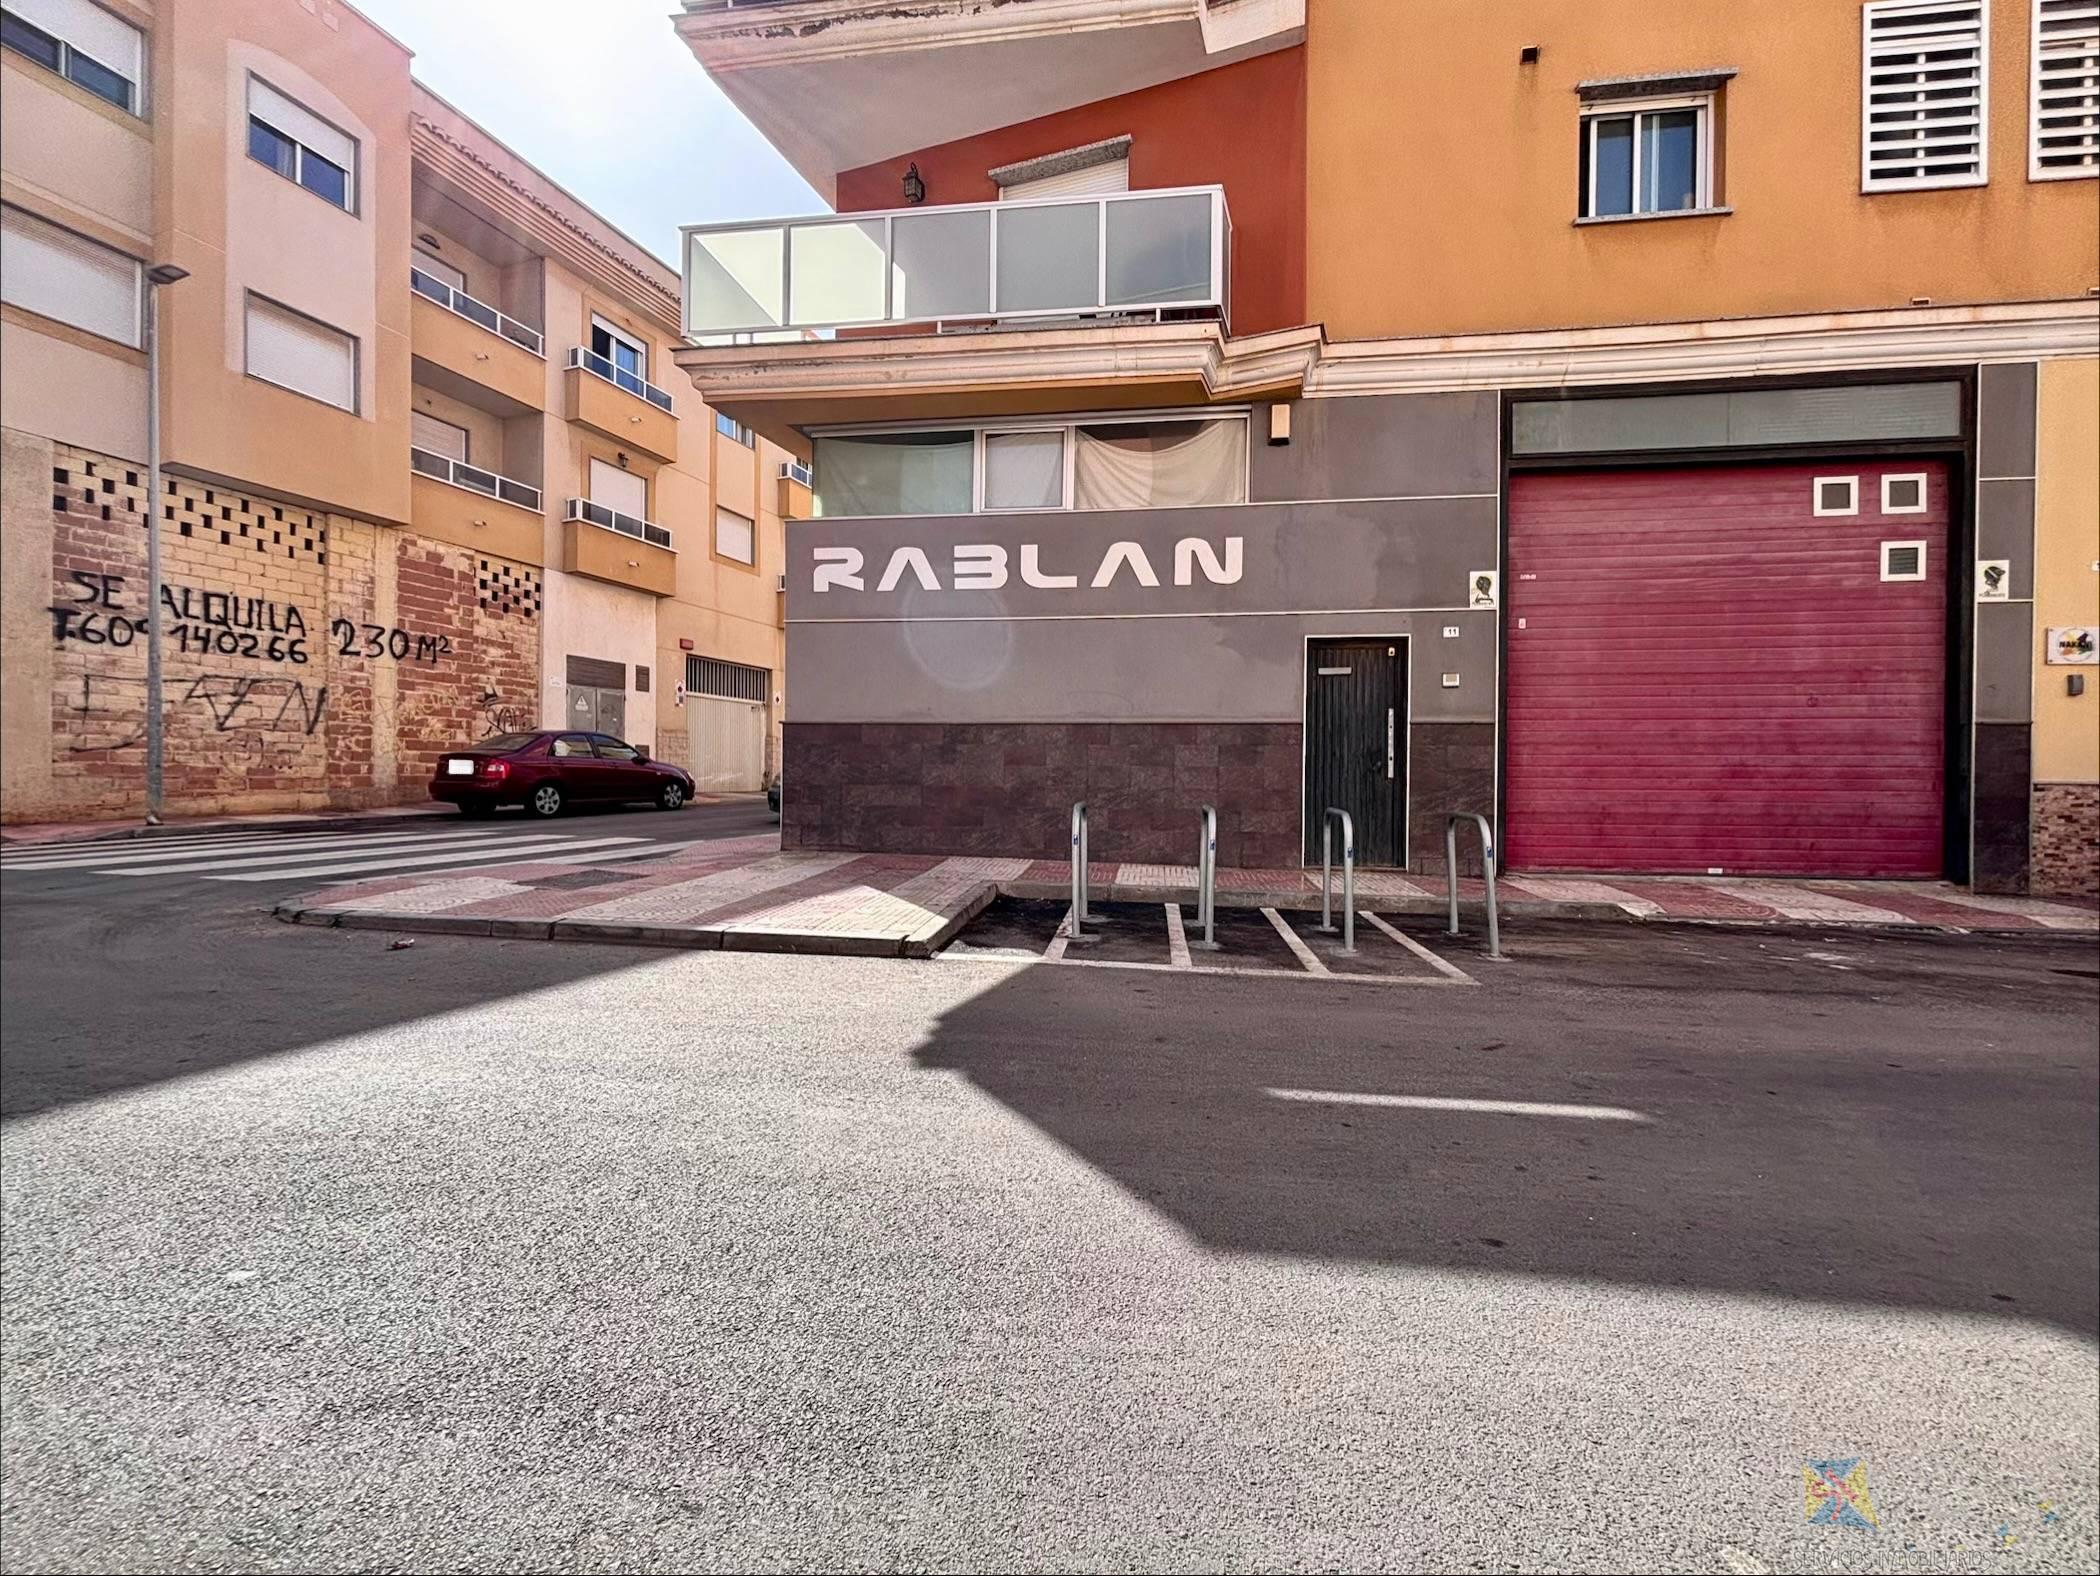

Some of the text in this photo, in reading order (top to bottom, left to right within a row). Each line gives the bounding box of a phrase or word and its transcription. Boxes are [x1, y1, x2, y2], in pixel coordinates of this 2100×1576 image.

[813, 536, 1244, 593] RABLAN
[72, 571, 125, 610] SE
[168, 623, 309, 664] 140266
[331, 618, 410, 661] 230
